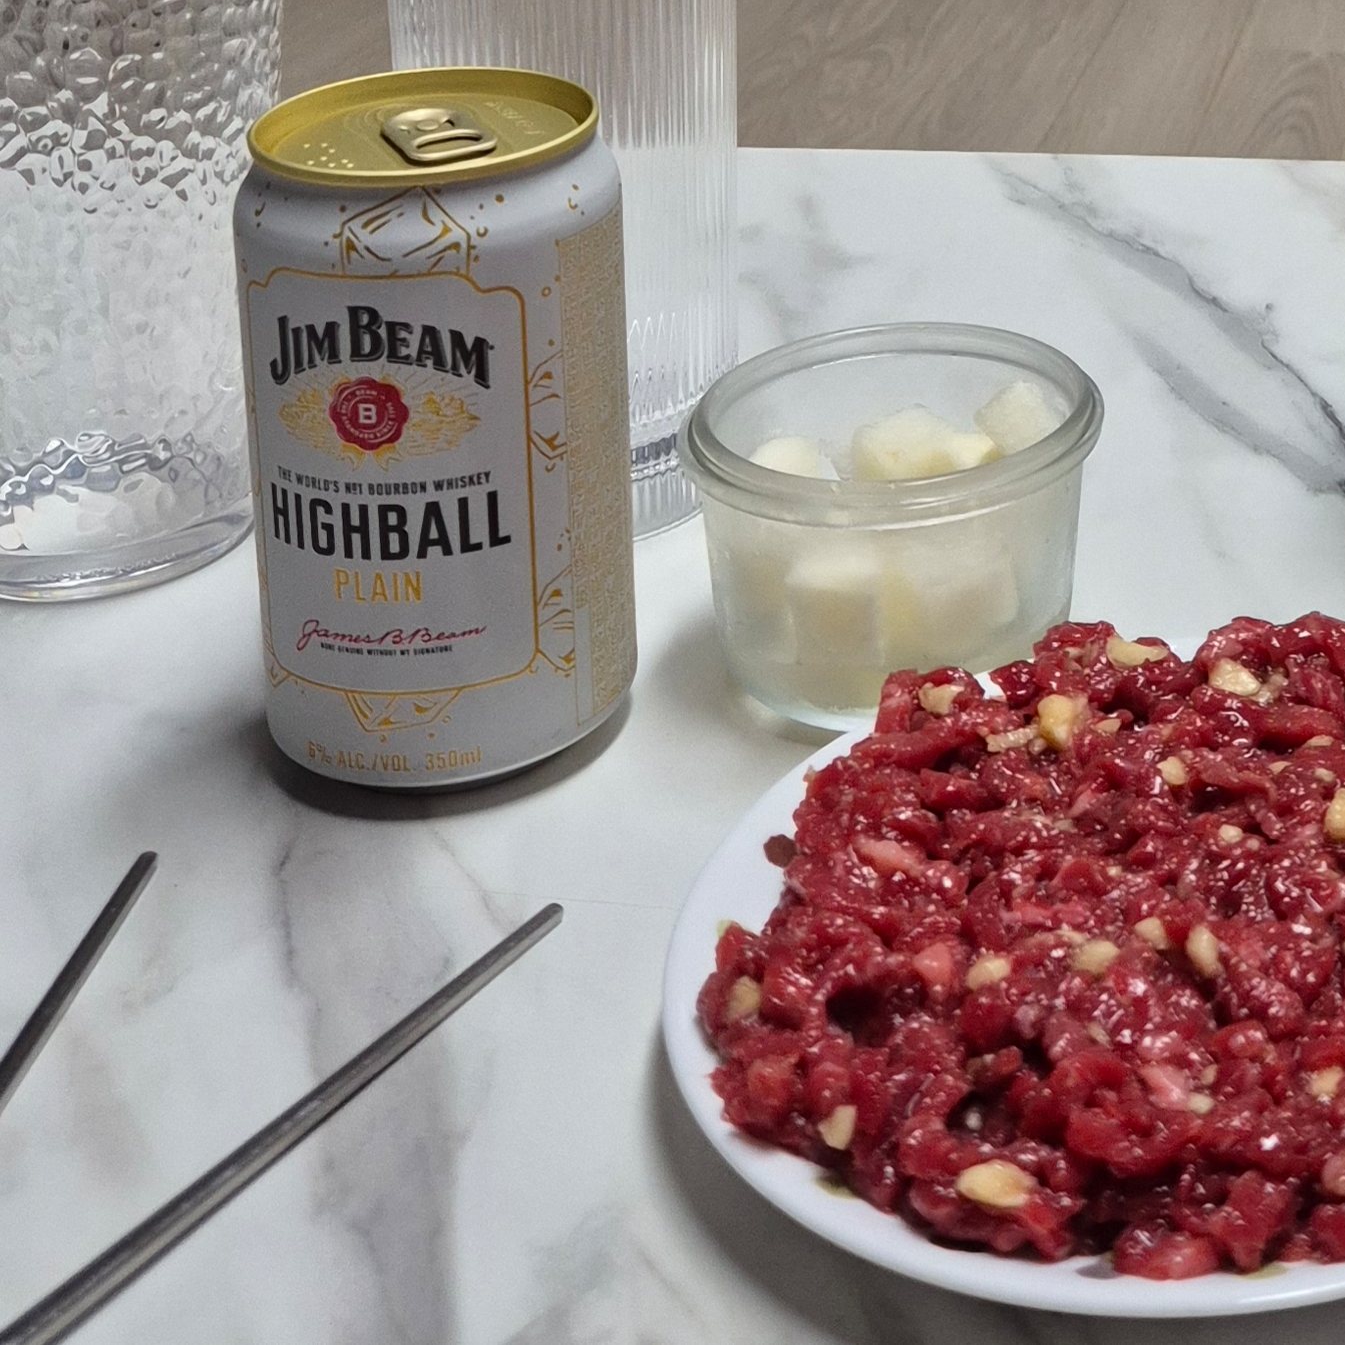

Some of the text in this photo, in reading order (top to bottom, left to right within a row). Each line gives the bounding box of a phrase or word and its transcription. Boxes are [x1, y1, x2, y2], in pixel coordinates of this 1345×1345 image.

[270, 306, 492, 390] JIM BEAM
[358, 403, 377, 424] B
[277, 465, 293, 483] THE
[295, 472, 340, 494] WORLD'S
[368, 480, 427, 496] BOURBON
[433, 470, 491, 493] WHISKEY
[271, 481, 512, 561] HIGHBALL
[334, 568, 423, 603] PLAIN
[296, 619, 377, 651] James
[306, 740, 332, 765] 6%
[425, 746, 482, 771] 350ml
